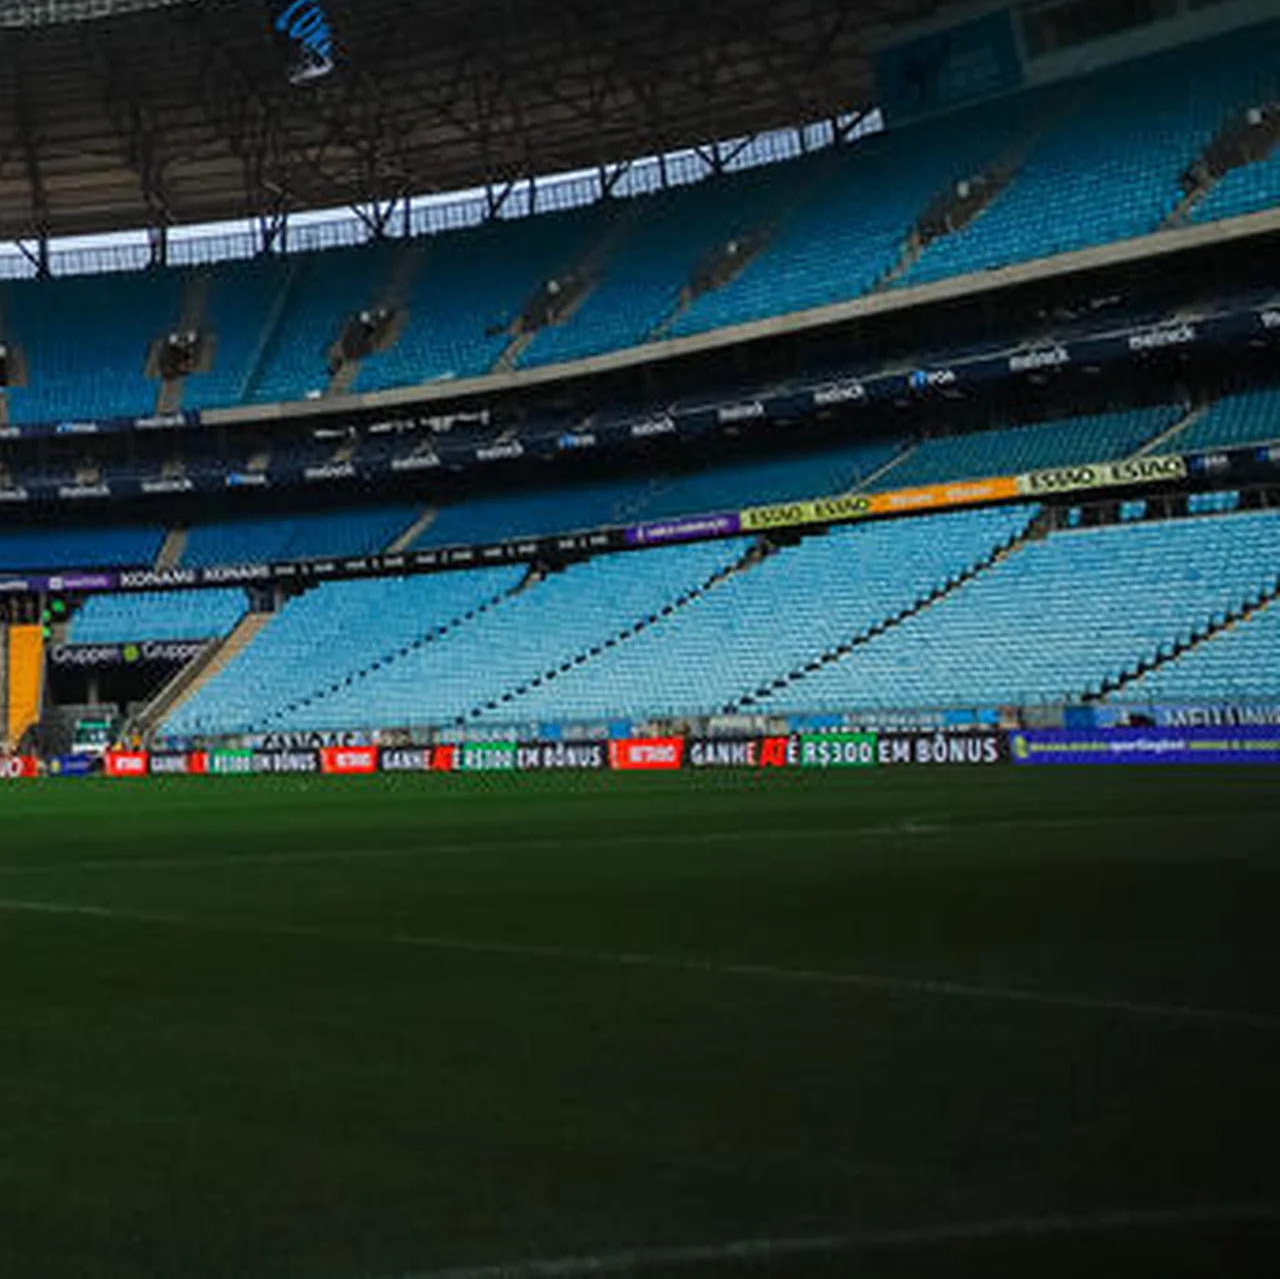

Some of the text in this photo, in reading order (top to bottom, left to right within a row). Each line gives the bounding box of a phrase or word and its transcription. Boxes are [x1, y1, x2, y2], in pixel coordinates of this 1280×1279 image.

[120, 570, 193, 587] KONAMI
[542, 738, 603, 767] BÔNUS
[691, 743, 756, 766] GANHE
[804, 740, 872, 768] R$300
[878, 741, 914, 763] EM
[916, 734, 998, 763] BÔNUS
